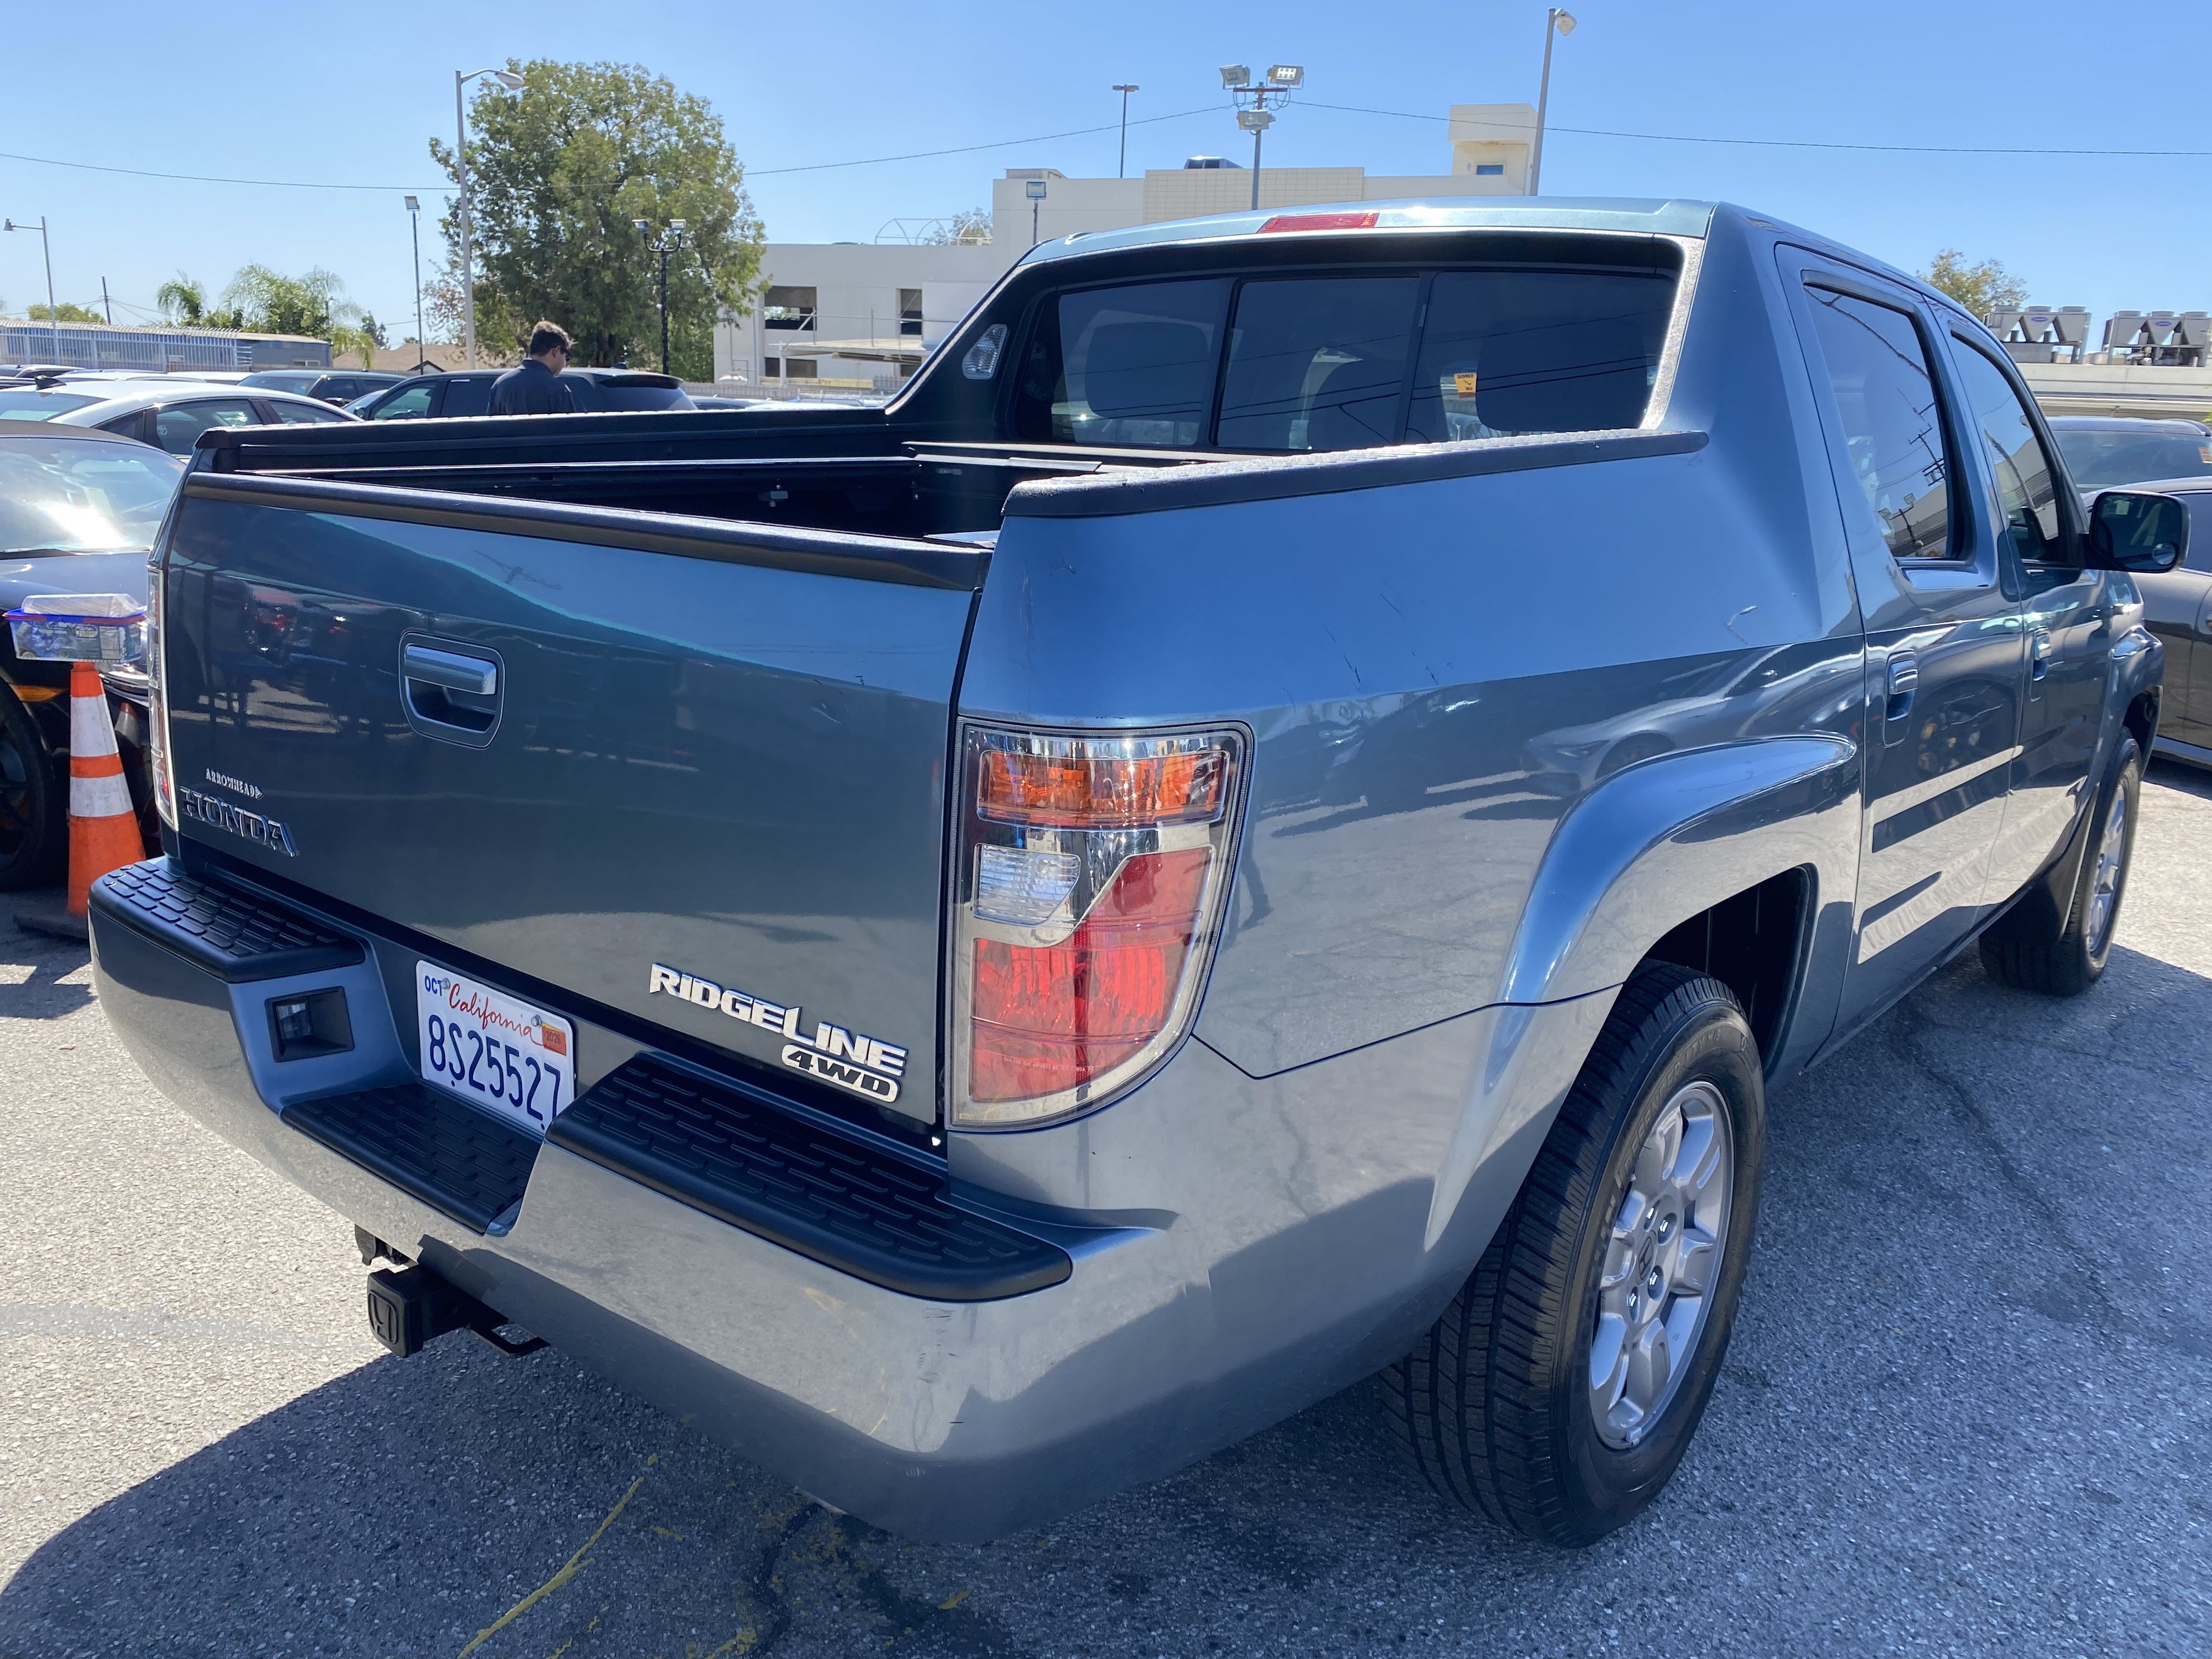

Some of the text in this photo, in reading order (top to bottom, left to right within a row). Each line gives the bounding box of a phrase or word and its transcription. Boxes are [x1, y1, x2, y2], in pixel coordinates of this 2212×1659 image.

[206, 768, 256, 797] ARROWHEAD
[179, 786, 300, 857] HONDA
[425, 975, 443, 996] OCT
[449, 983, 543, 1046] California
[546, 1031, 561, 1045] 2026
[650, 963, 908, 1076] RIDGELINE
[428, 1014, 561, 1121] 8S25527
[787, 1050, 890, 1096] 4WD
